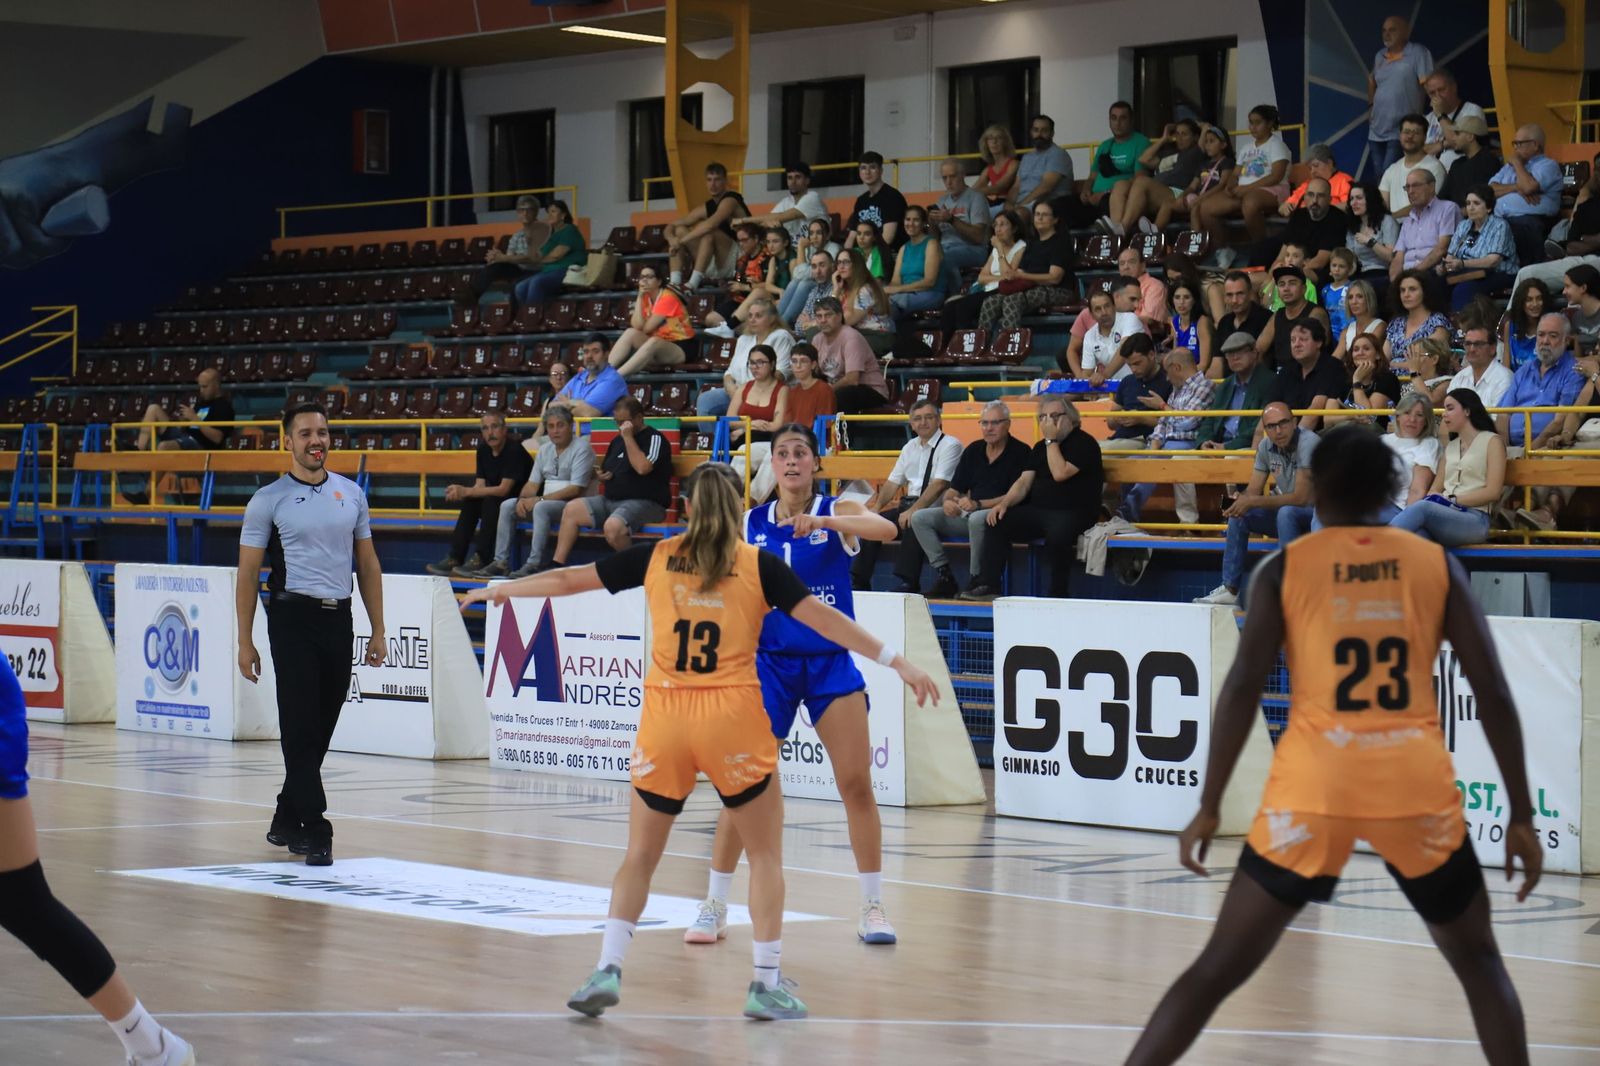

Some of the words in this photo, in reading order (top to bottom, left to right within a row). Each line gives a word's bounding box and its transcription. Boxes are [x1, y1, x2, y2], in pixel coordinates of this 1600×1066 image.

[144, 625, 200, 673] C&M
[673, 618, 721, 674] 13
[28, 647, 47, 680] 22
[1334, 636, 1411, 713] 23
[382, 684, 397, 694] FOOD
[405, 685, 427, 695] COFFEE
[515, 714, 528, 723] Tres
[530, 715, 554, 726] Cruces
[556, 717, 563, 726] 17
[565, 718, 578, 727] Entr
[589, 719, 610, 730] 49008
[611, 720, 638, 732] Zamora
[1003, 645, 1199, 780] G3C
[503, 730, 631, 750] marianandresasesoria@gmail.com
[503, 748, 519, 762] 980
[520, 750, 531, 763] 05
[533, 751, 544, 765] 85
[547, 752, 558, 766] 90
[566, 753, 584, 768] 605
[587, 755, 599, 770] 76
[601, 756, 613, 771] 71
[617, 757, 631, 772] 05
[1002, 756, 1060, 777] GIMNASIO
[1135, 766, 1199, 787] CRUCES
